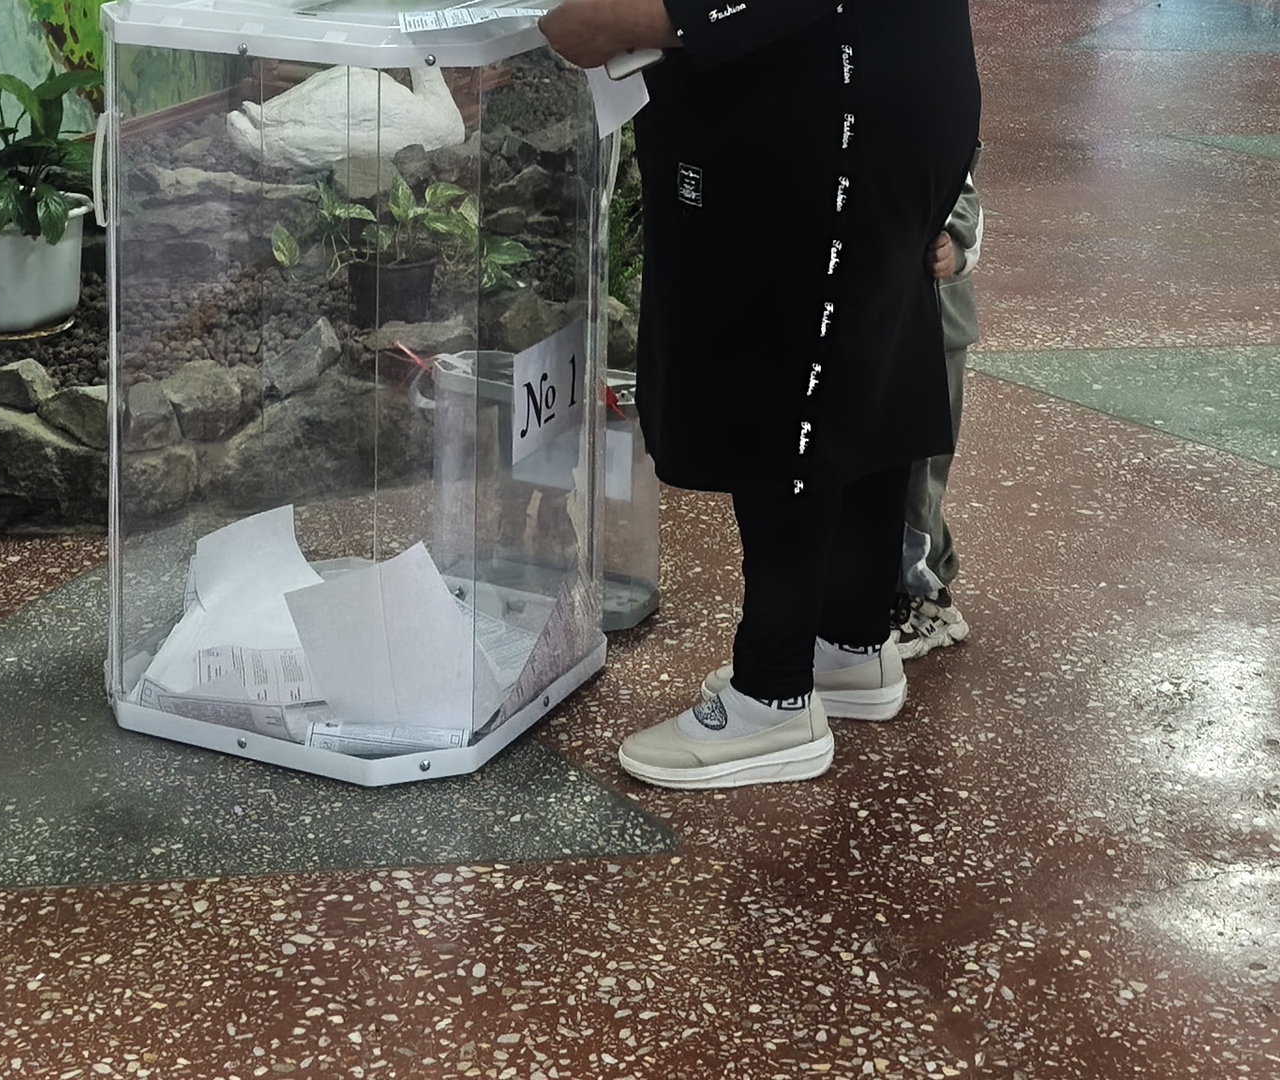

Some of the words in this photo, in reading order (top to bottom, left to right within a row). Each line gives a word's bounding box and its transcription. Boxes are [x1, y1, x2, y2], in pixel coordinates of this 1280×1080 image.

[708, 2, 747, 23] Fashion
[841, 44, 854, 84] Fashion
[521, 372, 556, 438] №
[568, 353, 577, 407] 1
